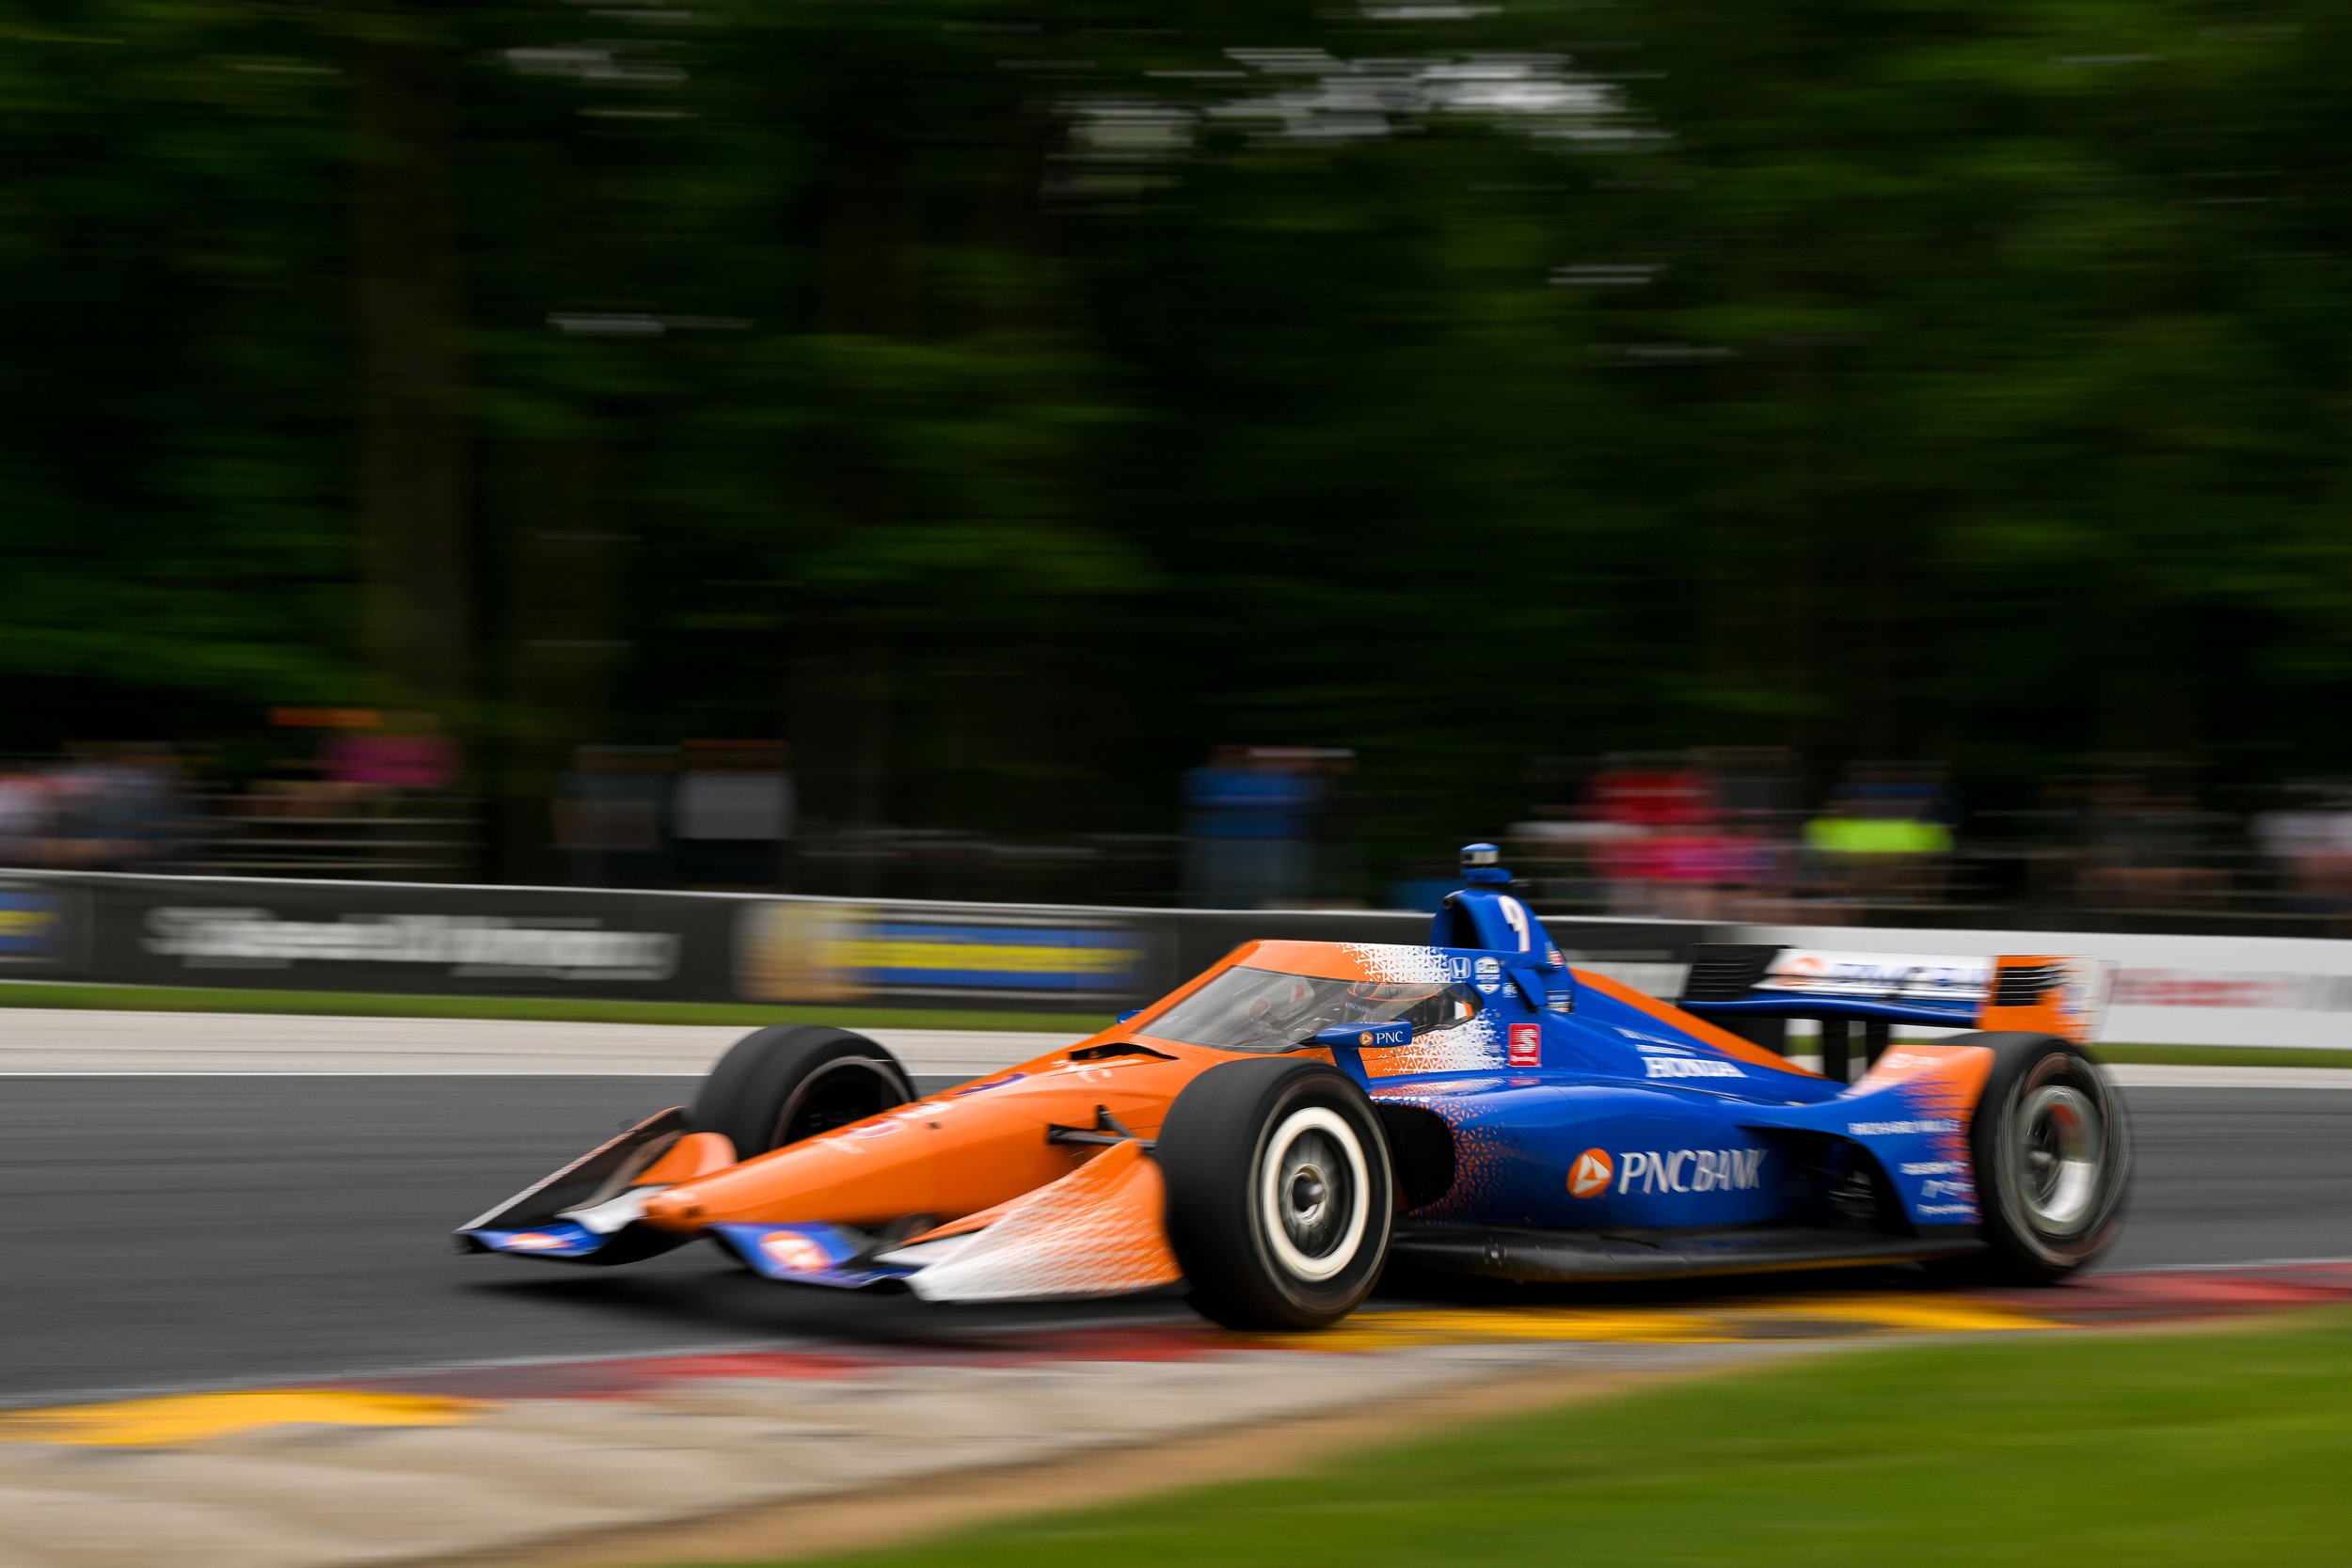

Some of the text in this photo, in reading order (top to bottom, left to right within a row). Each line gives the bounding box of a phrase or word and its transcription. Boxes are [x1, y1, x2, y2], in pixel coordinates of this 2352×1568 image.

[1498, 895, 1530, 952] 9
[1376, 1031, 1404, 1044] PNC
[1618, 1148, 1768, 1195] PNCBANK
